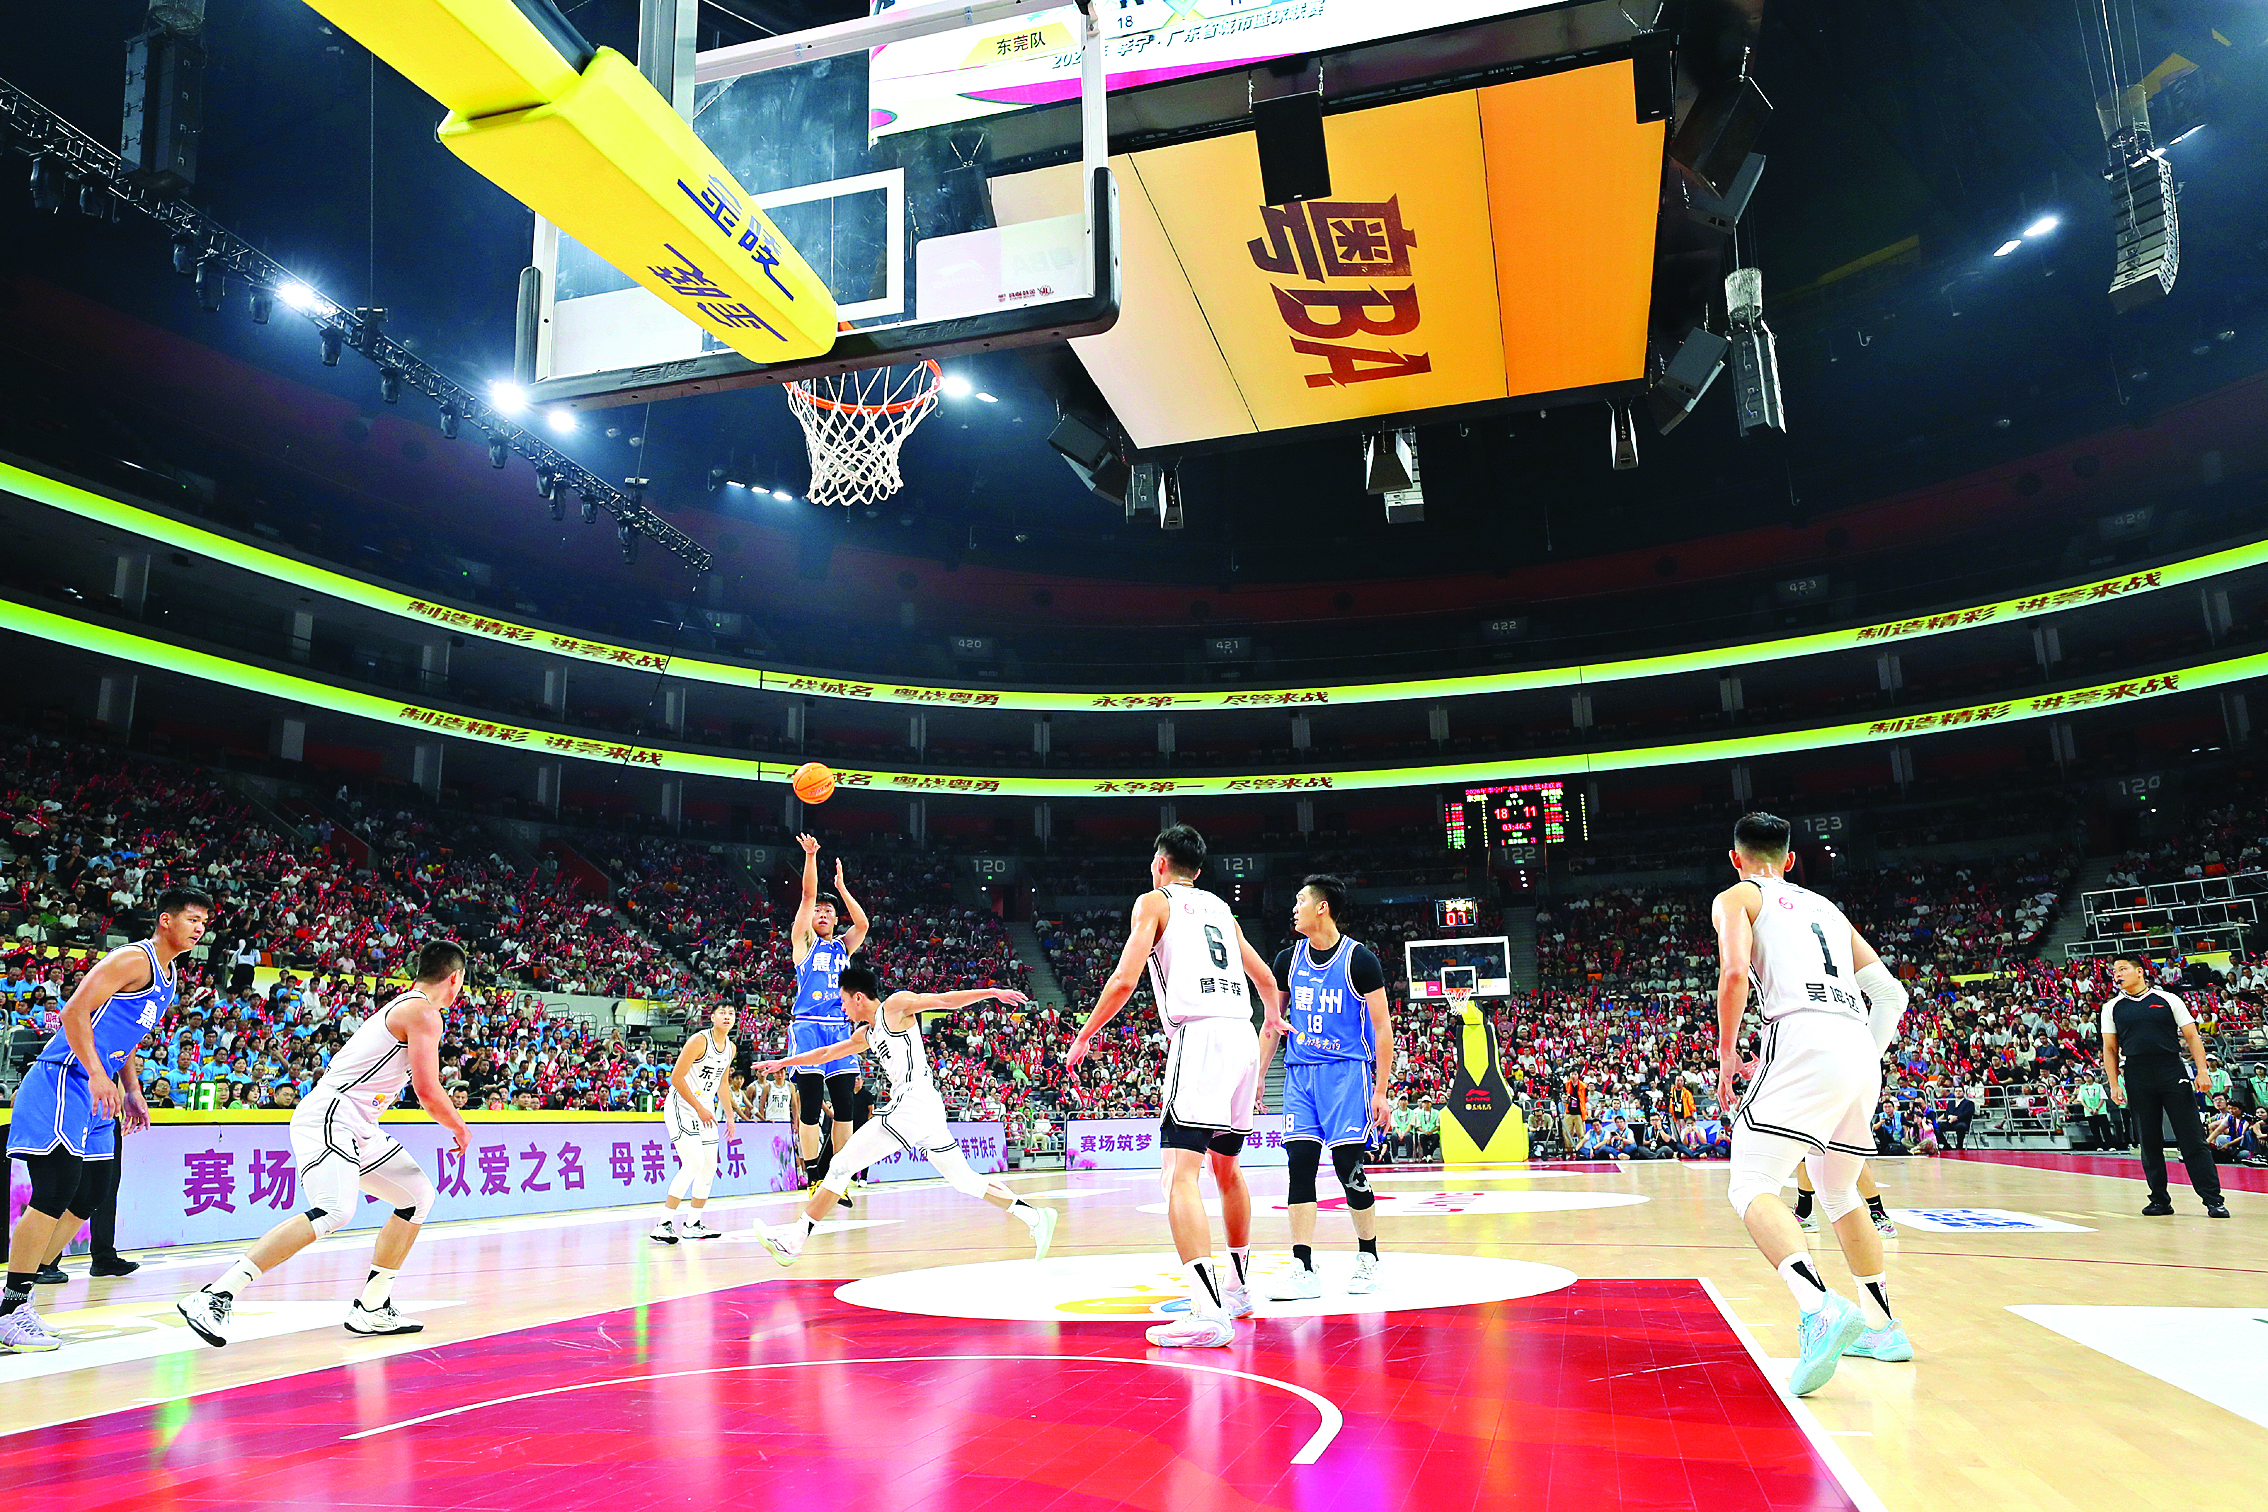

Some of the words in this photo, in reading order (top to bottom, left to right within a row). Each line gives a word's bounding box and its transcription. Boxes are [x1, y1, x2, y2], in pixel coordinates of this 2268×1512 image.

[1117, 16, 1134, 28] 18
[997, 31, 1046, 55] 东莞队
[1247, 193, 1431, 388] 粤BA
[1789, 580, 1816, 592] 423
[1855, 606, 1997, 641] 制造精彩
[2015, 571, 2161, 613] 进莞来战
[1492, 620, 1516, 630] 422
[407, 600, 536, 641] 制造精彩
[550, 636, 667, 672] 进莞来战
[958, 639, 981, 648] 420
[1216, 641, 1239, 649] 421
[1867, 704, 2012, 735] 制造精彩
[2029, 674, 2179, 713] 进莞来战
[398, 706, 531, 743] 制造精彩
[544, 736, 664, 767] 进莞来战
[1494, 808, 1509, 820] 18
[1523, 805, 1537, 817] 11
[1804, 816, 1842, 832] 123
[1502, 847, 1535, 861] 122
[973, 859, 1006, 872] 120
[1222, 858, 1254, 871] 121
[1204, 923, 1228, 970] 6
[1811, 922, 1838, 978] 1
[812, 952, 850, 972] 惠州
[828, 973, 839, 988] 13
[1294, 985, 1343, 1014] 惠州
[1307, 1013, 1323, 1033] 18
[954, 1136, 998, 1161] 亲节快乐
[1080, 1134, 1153, 1152] 赛场筑梦
[436, 1141, 586, 1197] 以爱之名
[609, 1138, 747, 1186] 母亲乐
